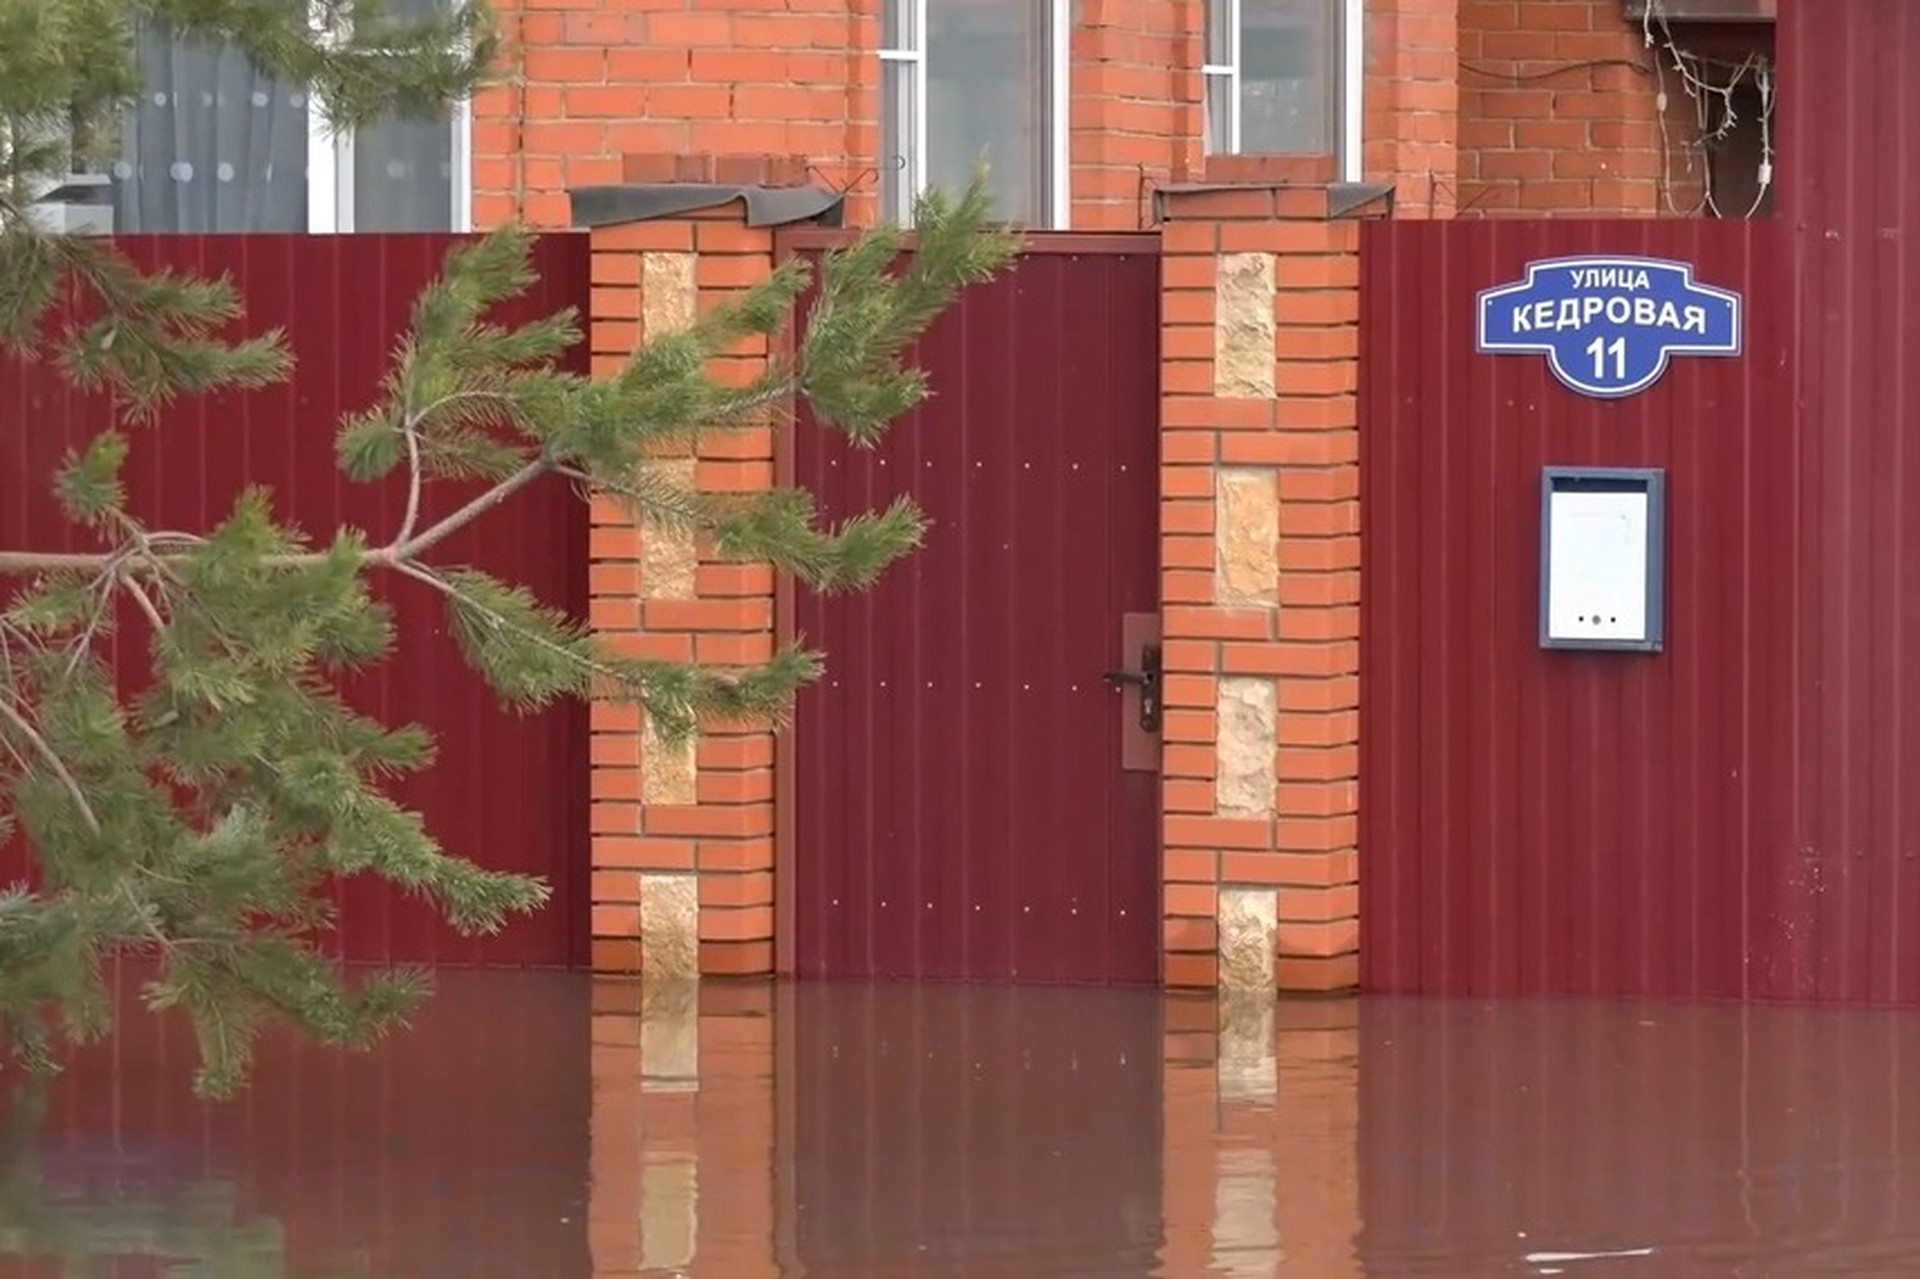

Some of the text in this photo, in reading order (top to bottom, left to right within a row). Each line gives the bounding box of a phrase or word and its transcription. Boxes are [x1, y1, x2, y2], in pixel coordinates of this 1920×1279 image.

[1570, 269, 1650, 291] УЛИЦА
[1513, 296, 1706, 334] КЕДРОВАЯ
[1586, 336, 1626, 379] 11
